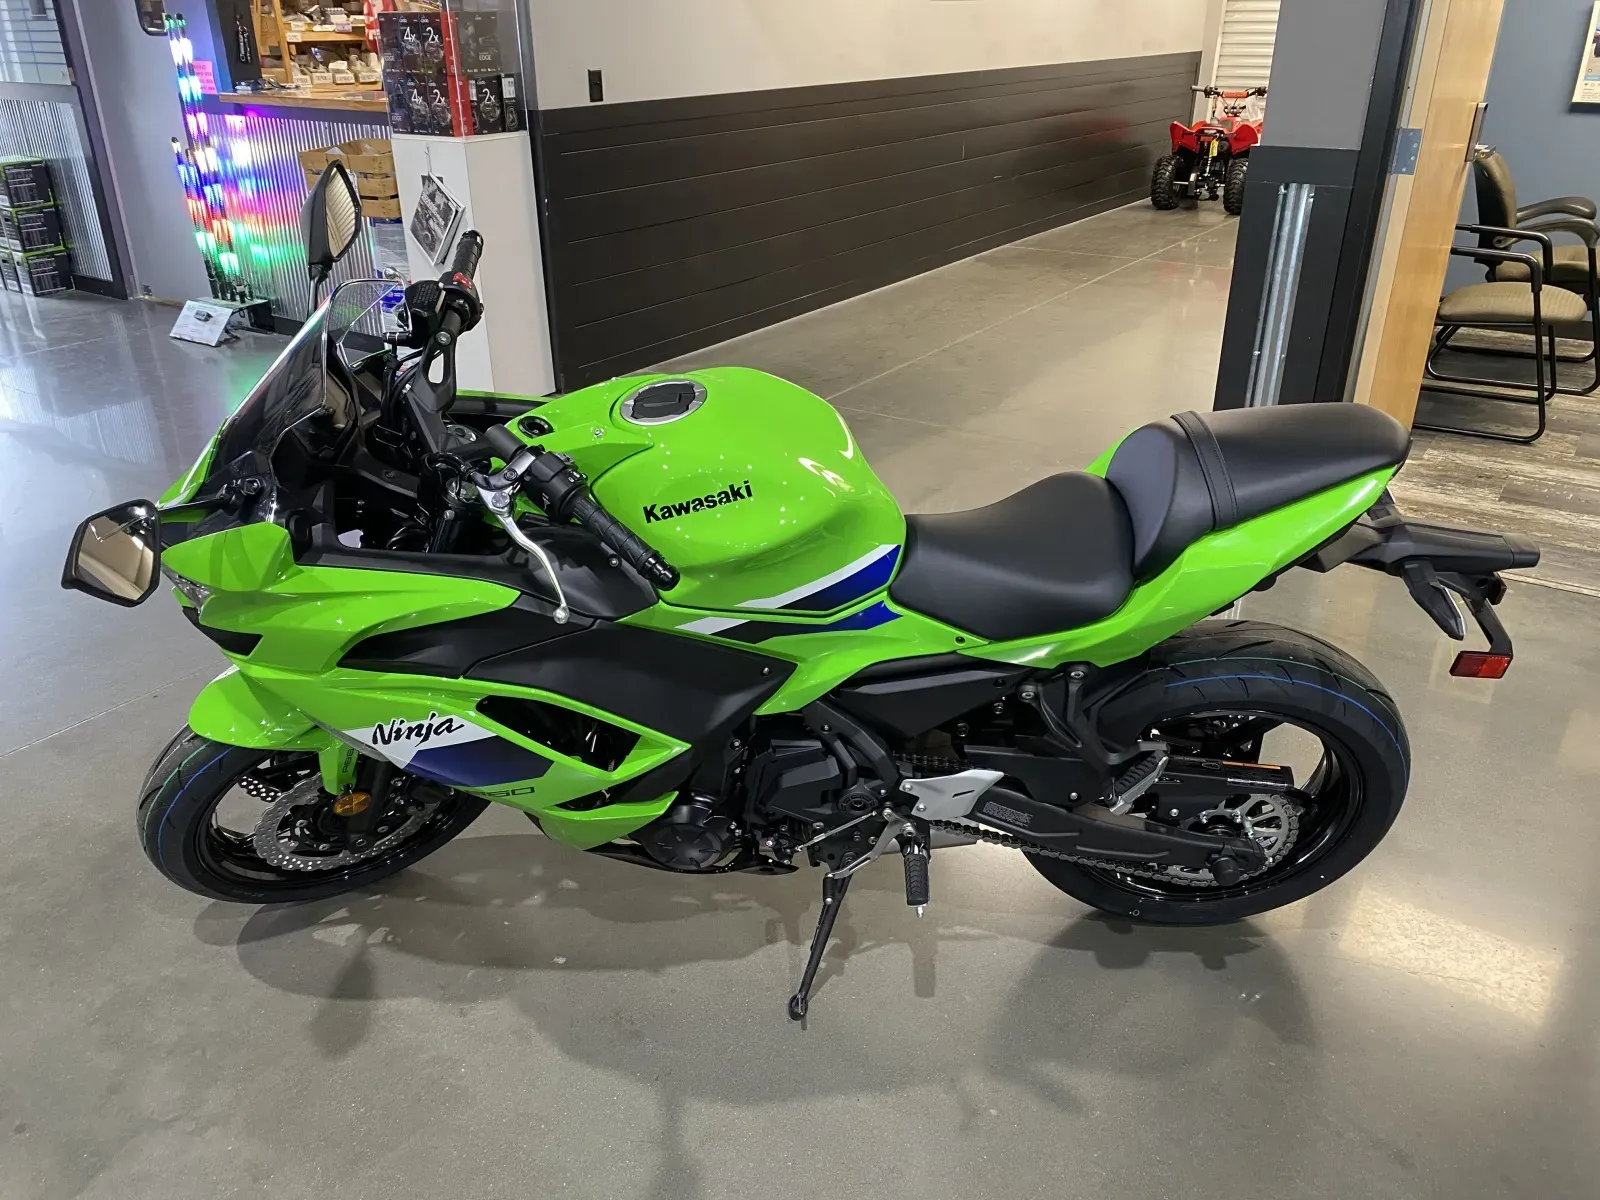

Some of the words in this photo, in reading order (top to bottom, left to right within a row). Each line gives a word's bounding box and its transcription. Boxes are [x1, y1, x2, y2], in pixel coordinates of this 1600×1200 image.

[426, 27, 440, 43] 2x
[433, 89, 446, 105] 2x
[482, 88, 496, 104] 2x
[642, 480, 753, 524] Kawasaki
[371, 712, 465, 748] Ninja
[472, 786, 535, 798] 50
